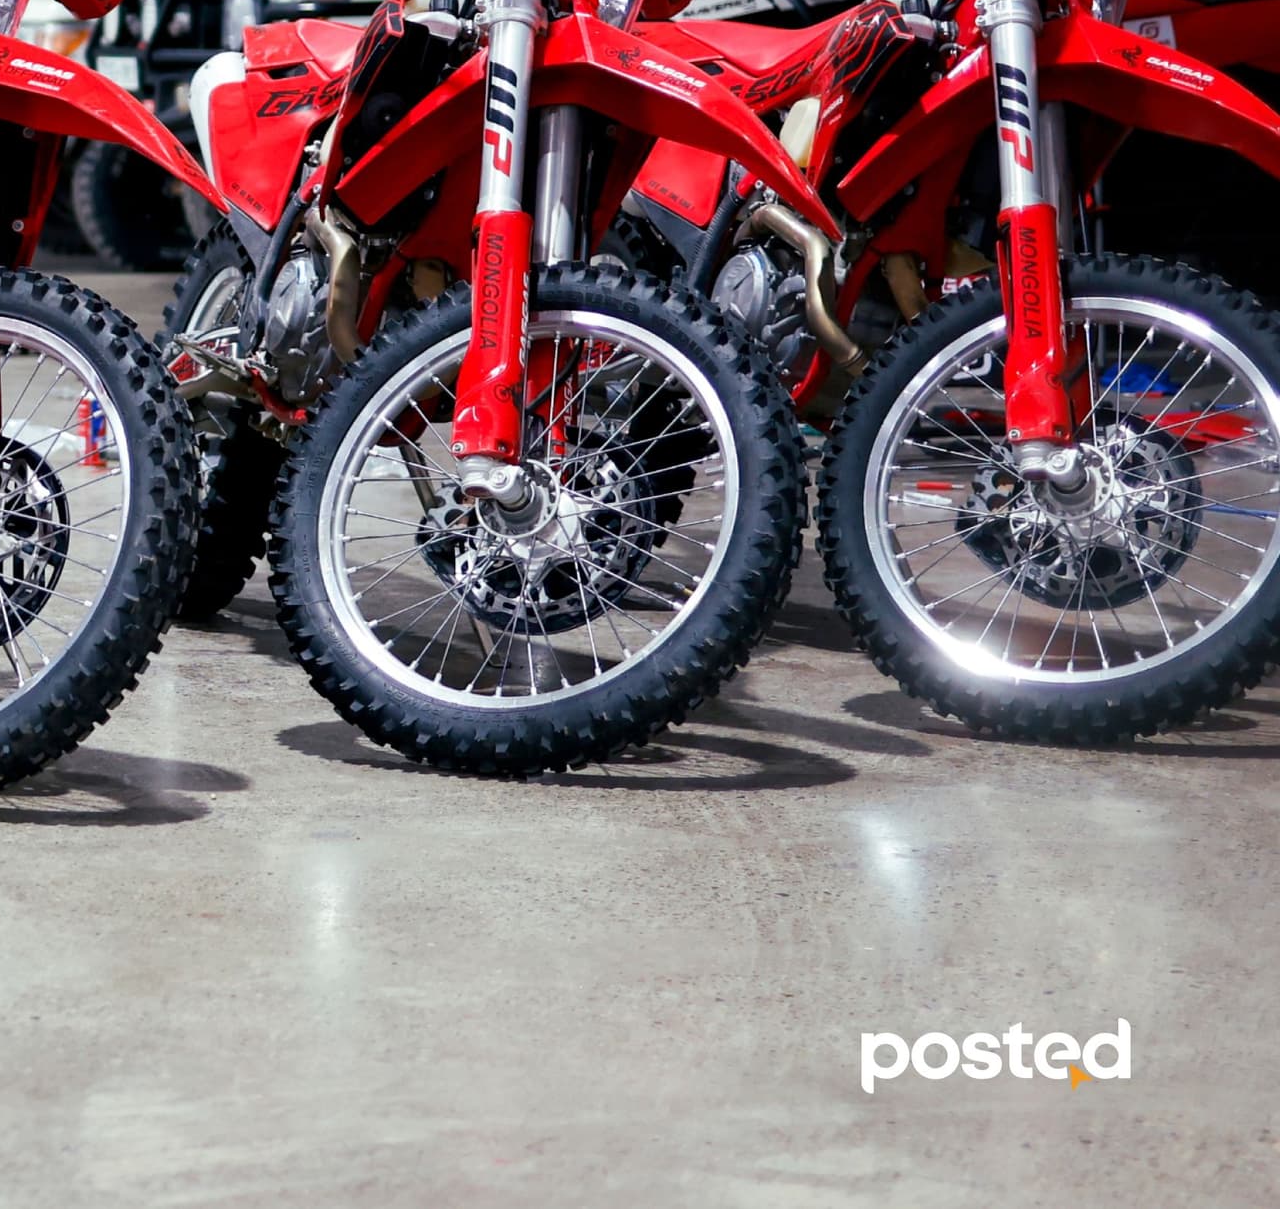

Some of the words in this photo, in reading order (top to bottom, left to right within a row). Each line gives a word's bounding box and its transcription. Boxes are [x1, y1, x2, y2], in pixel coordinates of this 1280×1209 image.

[10, 58, 76, 80] GASGAS
[484, 61, 517, 178] WP
[641, 59, 707, 88] GASGAS
[995, 62, 1034, 174] WP
[1146, 56, 1215, 82] GASGAS
[479, 233, 504, 349] MONGOLIA
[1018, 226, 1043, 339] MONGOLIA
